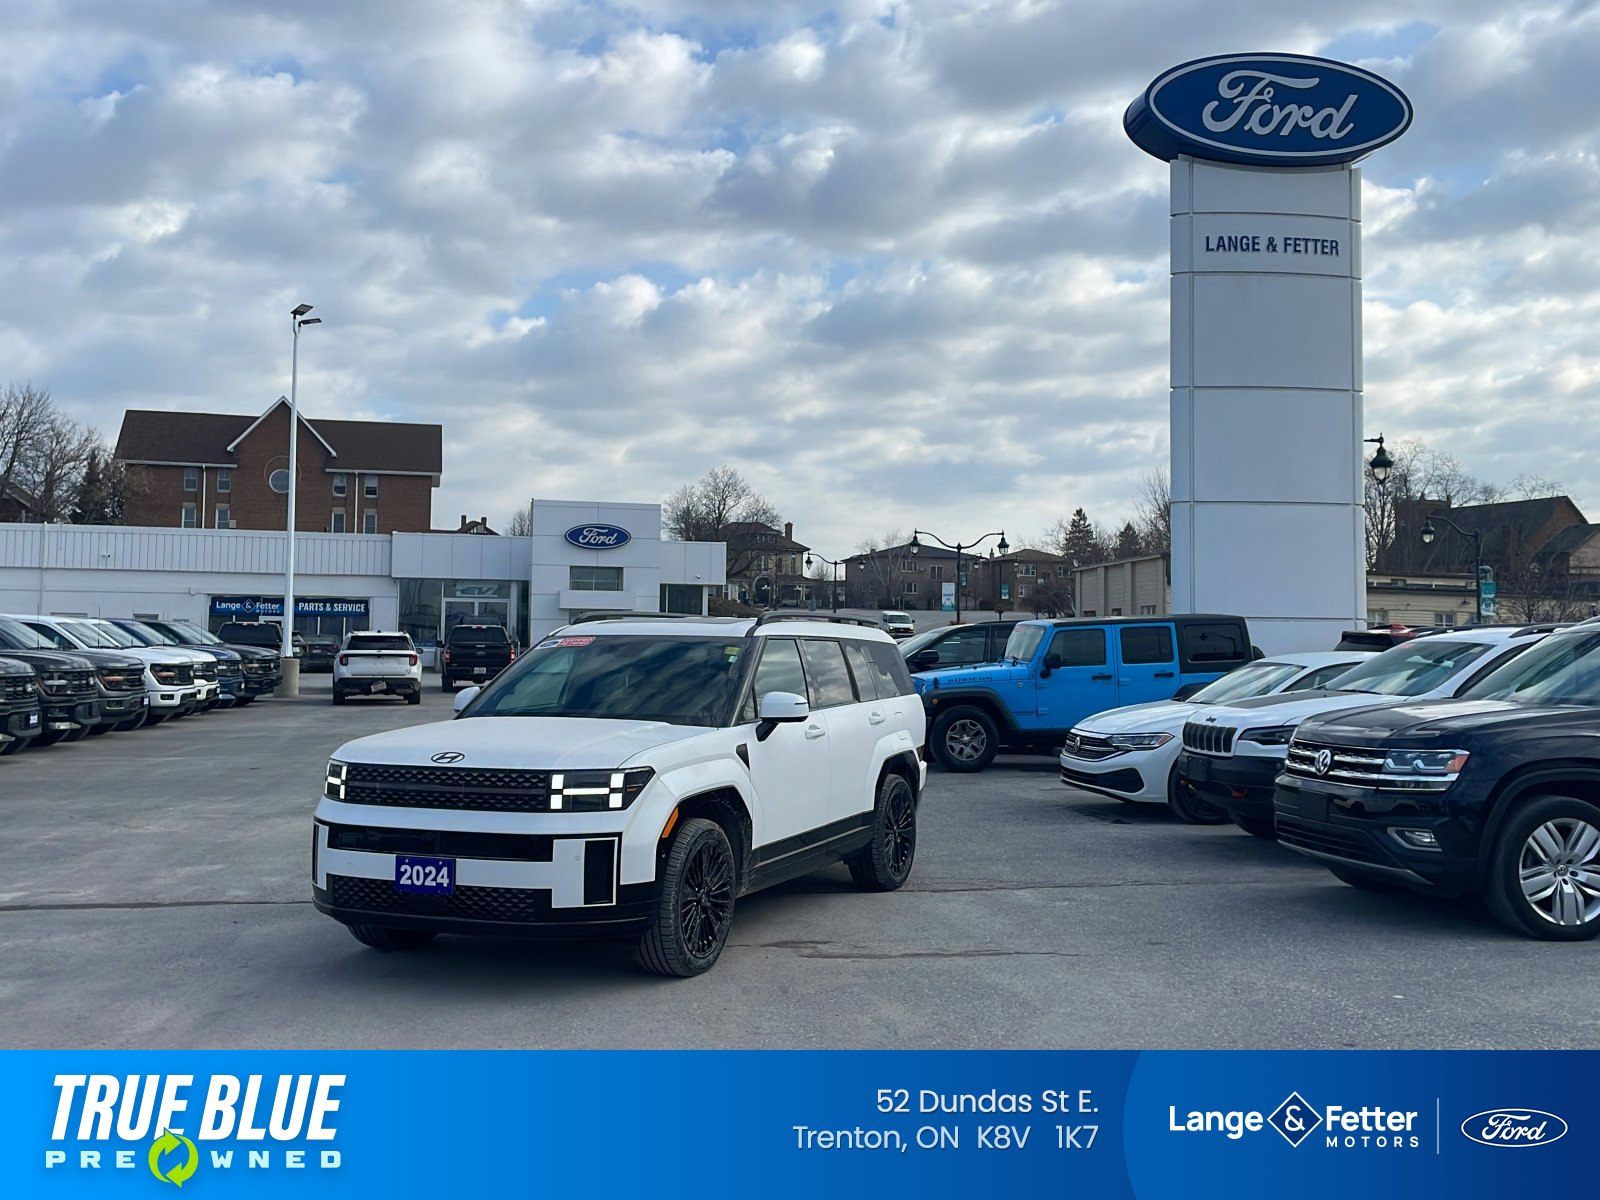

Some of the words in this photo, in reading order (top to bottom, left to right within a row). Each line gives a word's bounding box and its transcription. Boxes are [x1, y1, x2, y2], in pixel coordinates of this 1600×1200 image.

[1202, 69, 1359, 140] Ford
[1205, 235, 1260, 252] LANGE
[1266, 236, 1277, 253] &
[1283, 236, 1340, 256] FETTER
[578, 527, 618, 545] Ford
[216, 601, 241, 611] Lange
[256, 602, 280, 610] Fetter
[298, 602, 324, 612] PARTS
[325, 603, 332, 612] &
[333, 603, 366, 613] SERVICE
[947, 676, 993, 684] RUBICON
[399, 864, 450, 888] 2024
